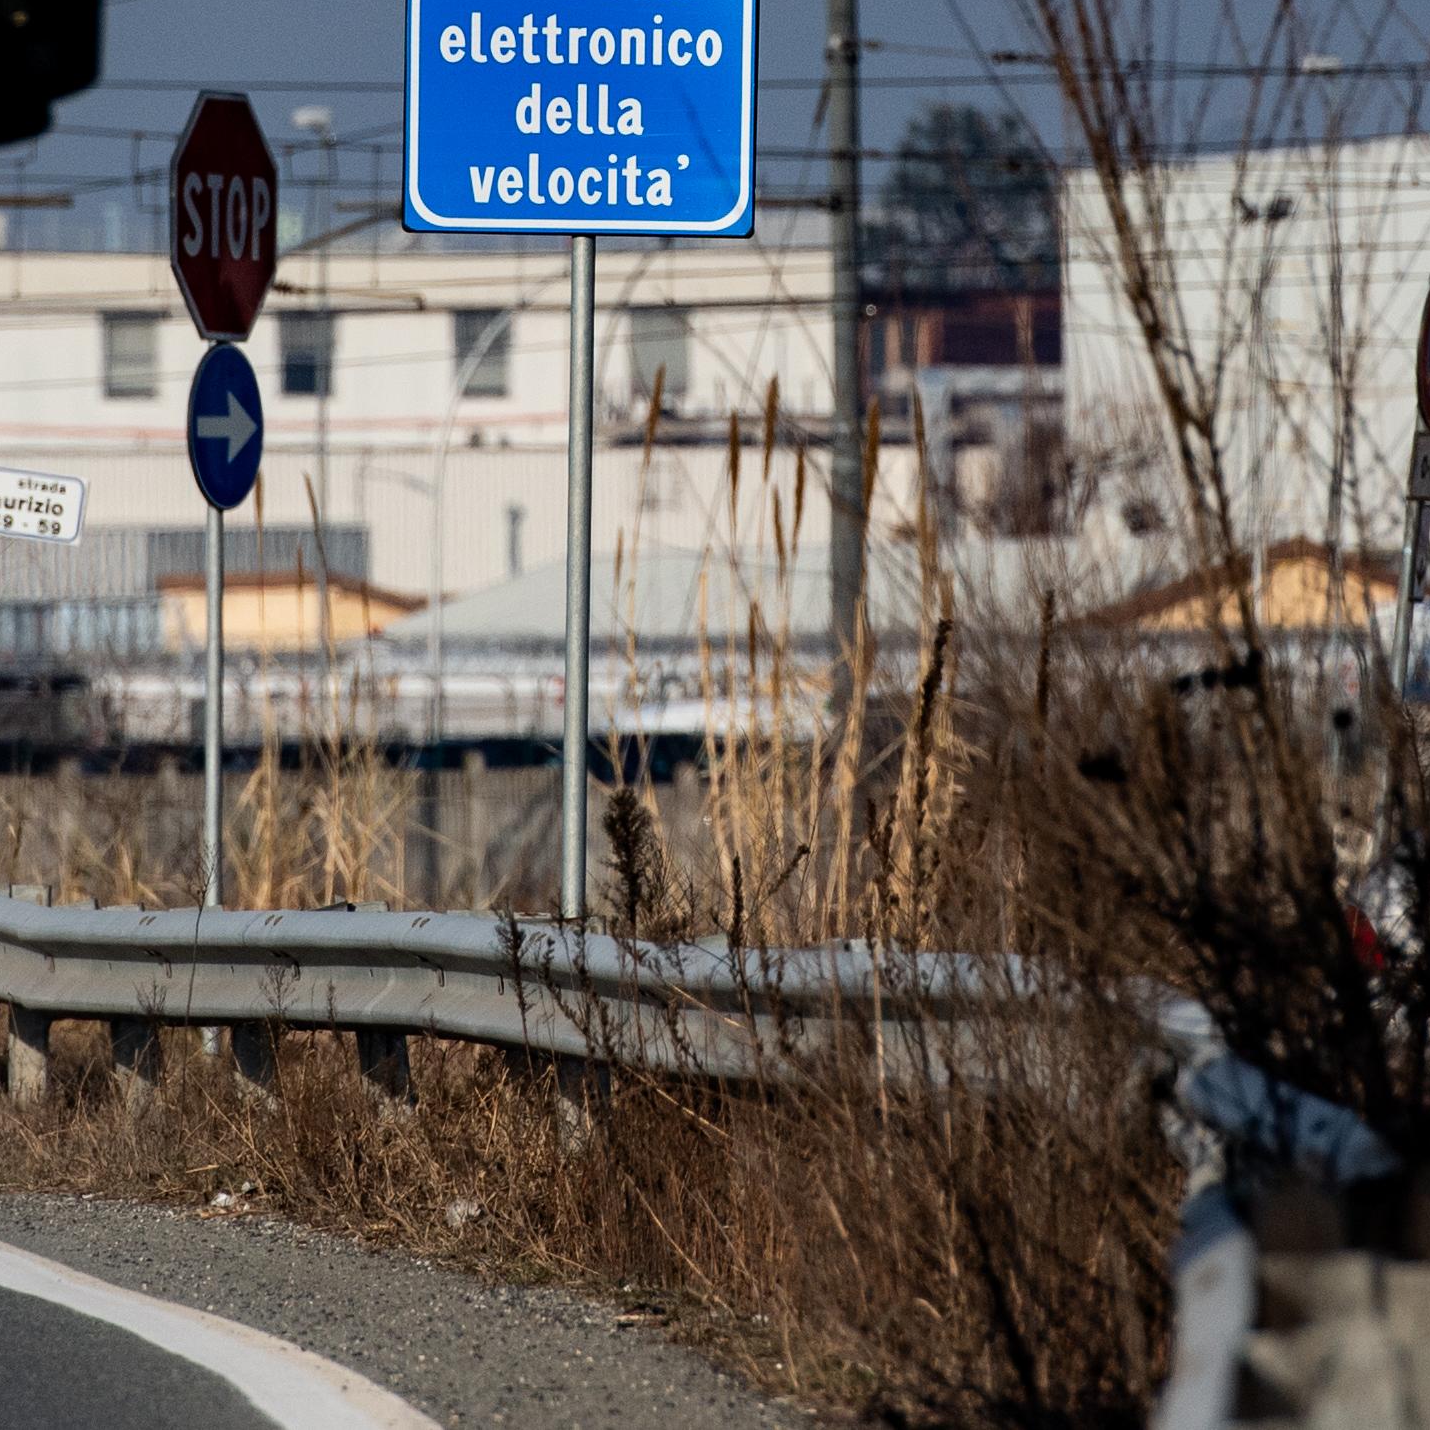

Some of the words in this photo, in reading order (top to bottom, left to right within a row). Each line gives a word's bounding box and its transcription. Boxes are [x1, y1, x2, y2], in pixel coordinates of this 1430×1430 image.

[439, 12, 723, 67] elettronico
[515, 83, 645, 136] della
[184, 172, 270, 261] STOP
[19, 478, 66, 495] strada
[38, 519, 61, 535] 59
